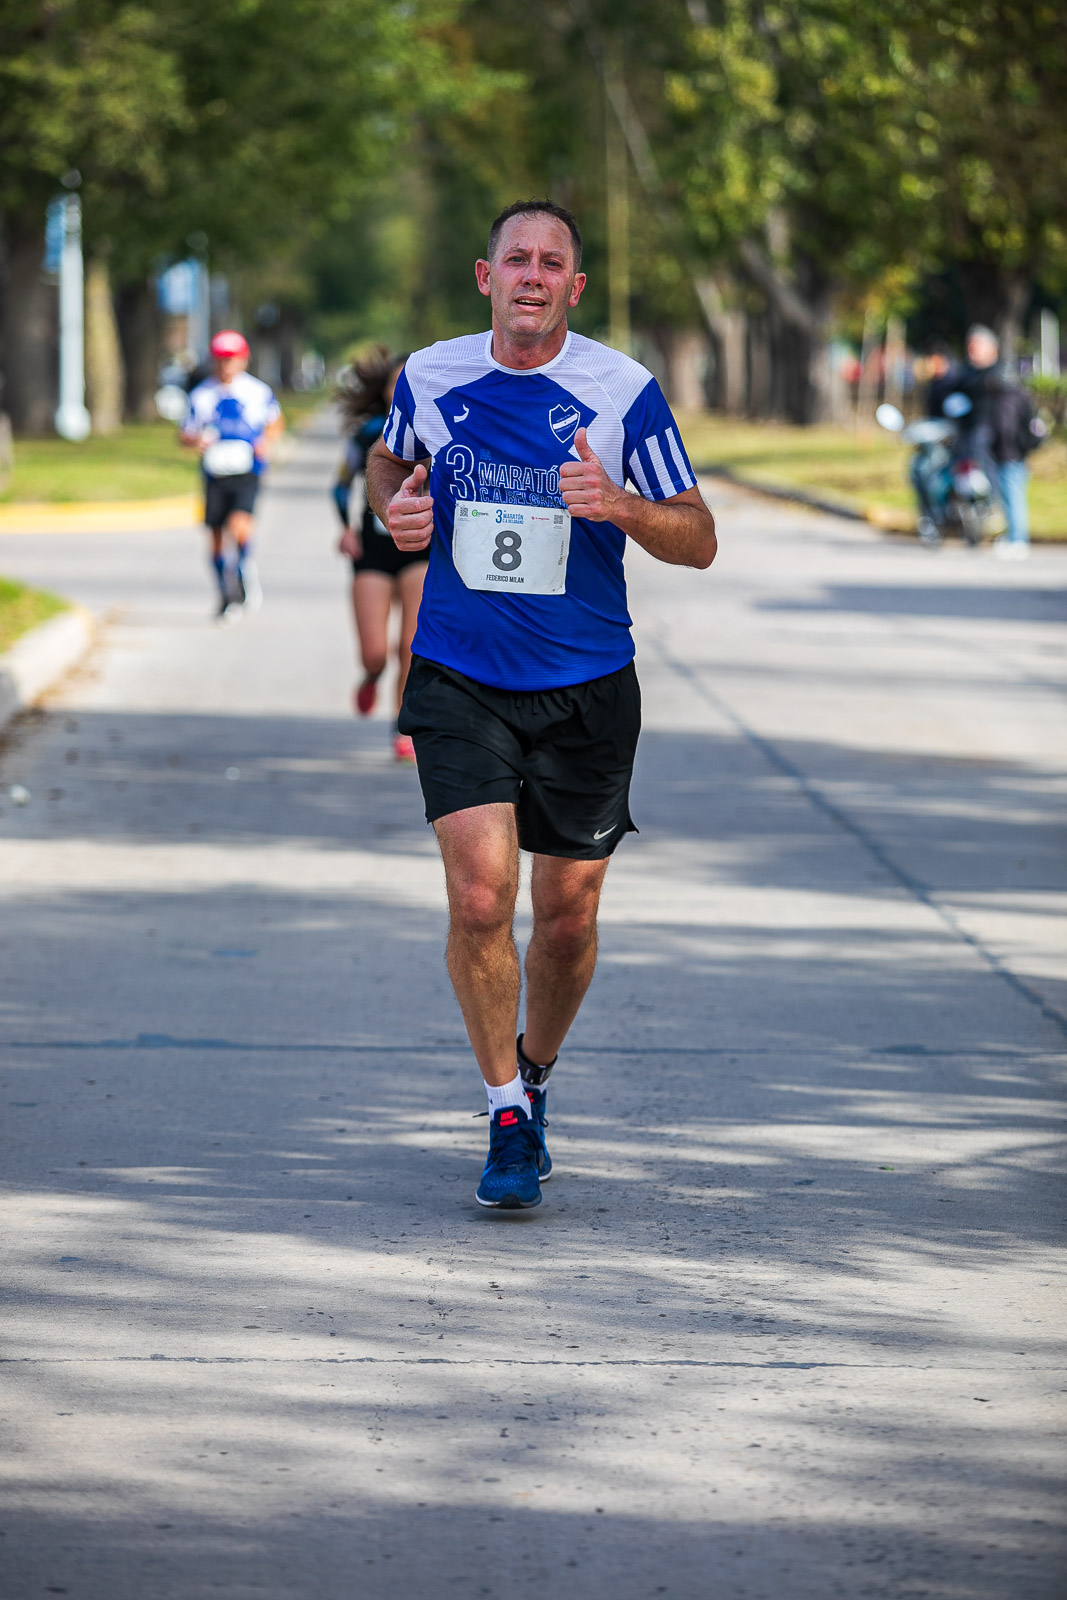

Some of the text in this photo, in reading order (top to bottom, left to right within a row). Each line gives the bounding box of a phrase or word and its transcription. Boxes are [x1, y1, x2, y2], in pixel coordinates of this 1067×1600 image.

[446, 444, 562, 502] 3 MARATÓ
[495, 509, 503, 524] 3
[492, 530, 522, 571] 8
[486, 574, 508, 582] FEDERICO
